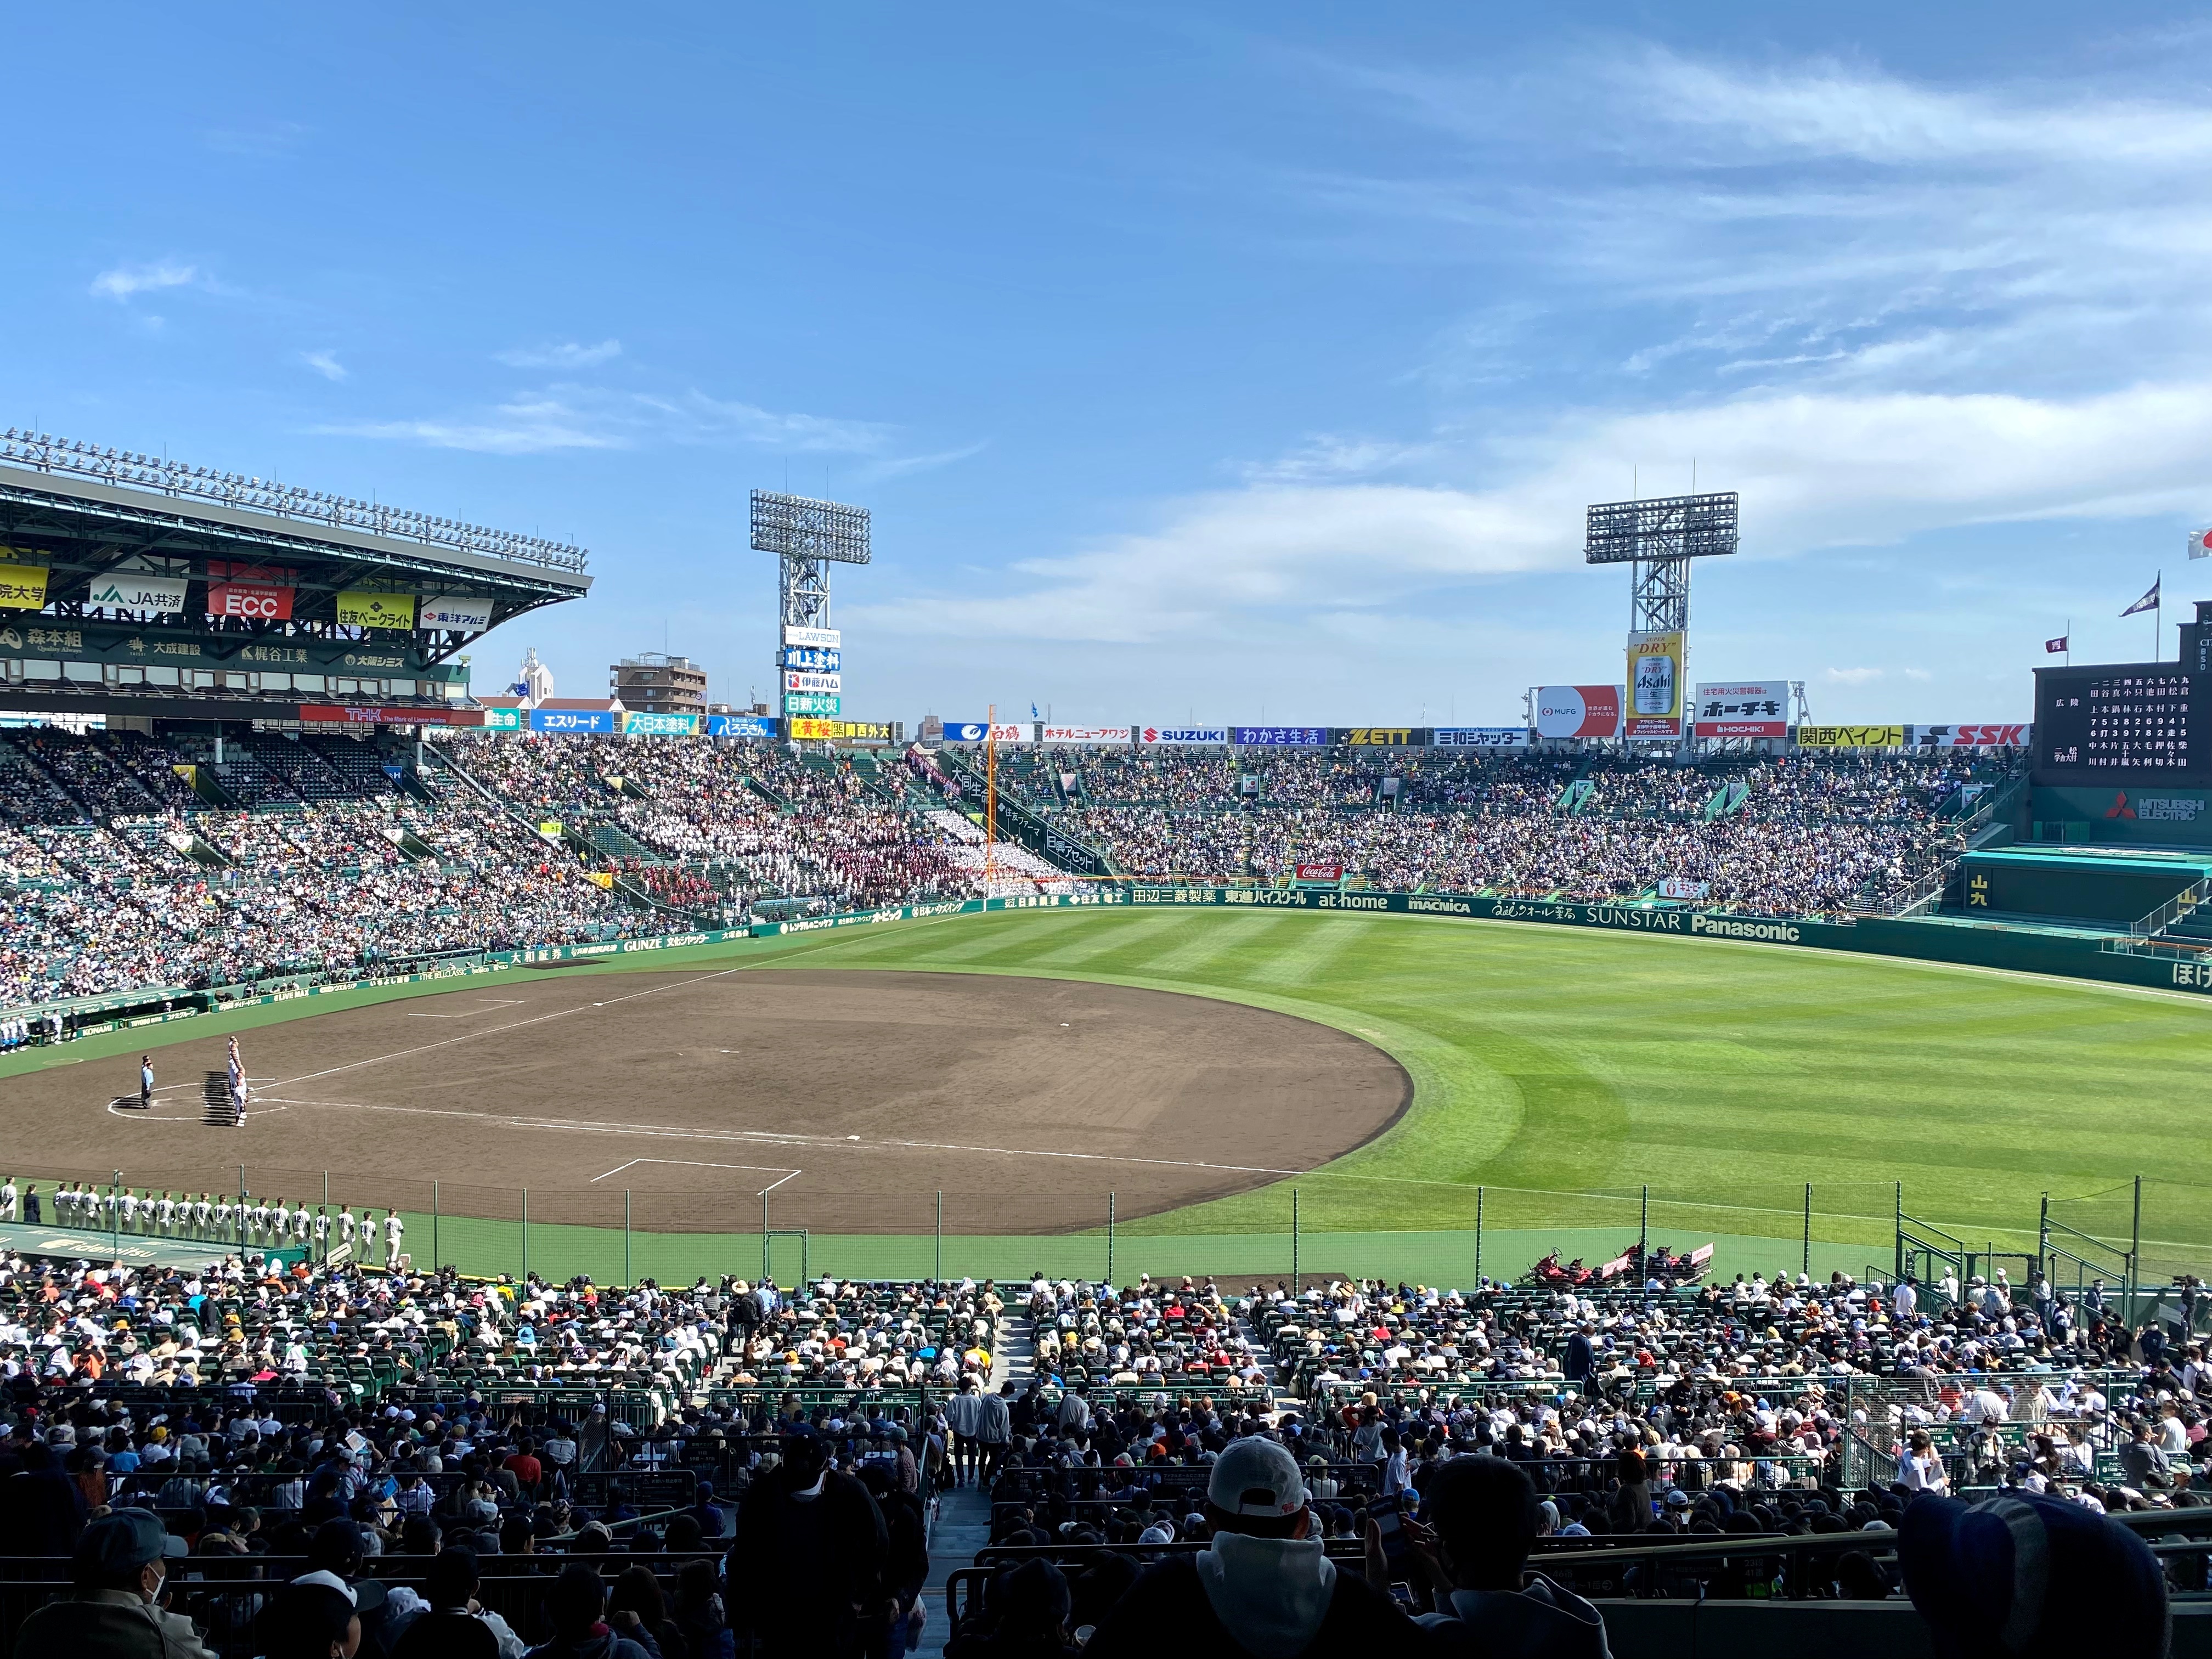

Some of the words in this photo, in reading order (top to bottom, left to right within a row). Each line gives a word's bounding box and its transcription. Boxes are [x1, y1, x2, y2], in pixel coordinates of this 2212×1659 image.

[128, 591, 181, 607] JA共済
[226, 595, 278, 617] ECC
[339, 609, 410, 628] 住友ベークライト
[437, 612, 487, 625] 東洋アルミ
[27, 629, 82, 647] 森本組
[799, 631, 839, 643] LAWSON
[153, 642, 201, 656] 大成建設
[255, 646, 308, 663] 梶谷工業
[787, 651, 839, 669] 川上塗料
[802, 677, 838, 689] 伊藤ハム
[1637, 674, 1671, 689] Asahi
[1703, 687, 1767, 696] 住宅用火災警報器は
[788, 697, 837, 712] 日新火災
[1702, 701, 1780, 717] ホーチキ
[2056, 698, 2079, 707] 広陵
[345, 708, 382, 721] THK
[544, 715, 600, 729] エスリード
[631, 715, 690, 733] 大日本塗料
[801, 720, 831, 737] 黄桜
[731, 724, 767, 736] ろうきん
[846, 724, 889, 738] 関西外大
[992, 725, 1020, 741] 白鶴
[1045, 728, 1130, 740] ホテルニューアワジ
[1162, 730, 1224, 741] SUZUKI
[1243, 728, 1319, 744] わかさ生活
[1348, 729, 1412, 745] ZETT
[1800, 727, 1902, 745] 関西ペイント
[1954, 725, 2026, 745] SSK
[2100, 729, 2108, 737] 打
[2167, 729, 2176, 737] 走
[1439, 732, 1522, 745] 三和シャッター
[952, 766, 989, 804] 大同生命
[2139, 798, 2205, 811] MITSUBISHI
[2139, 809, 2196, 821] ELECTRIC
[1005, 808, 1040, 837] 住友ファーマ
[1048, 836, 1092, 870] 日興アセット
[1302, 866, 1337, 878] Coca-Cola
[1680, 882, 1701, 892] キューピー
[1971, 874, 1988, 906] 山九
[1019, 895, 1059, 907] 日鉄鋼板
[1081, 894, 1124, 904] 住友電工
[1133, 889, 1216, 903] 田辺三菱製薬
[1224, 890, 1306, 905] 東進ハイスクール
[1319, 894, 1336, 907] at
[1339, 892, 1387, 909] home
[919, 901, 964, 916] 日本ハウズイング
[1519, 906, 1576, 920] クオール薬局
[789, 918, 833, 932] レンタルのニッケン
[1587, 908, 1681, 930] SUNSTAR
[721, 930, 749, 939] 大塚商会
[1691, 914, 1800, 942] Panasonic
[623, 938, 663, 952] GUNZE
[510, 950, 562, 964] 大和証券
[422, 972, 433, 980] THE
[2173, 963, 2212, 988] ほけ
[294, 989, 309, 998] MAX
[166, 1010, 196, 1020] コナミグループ
[82, 1024, 113, 1036] KONAMI
